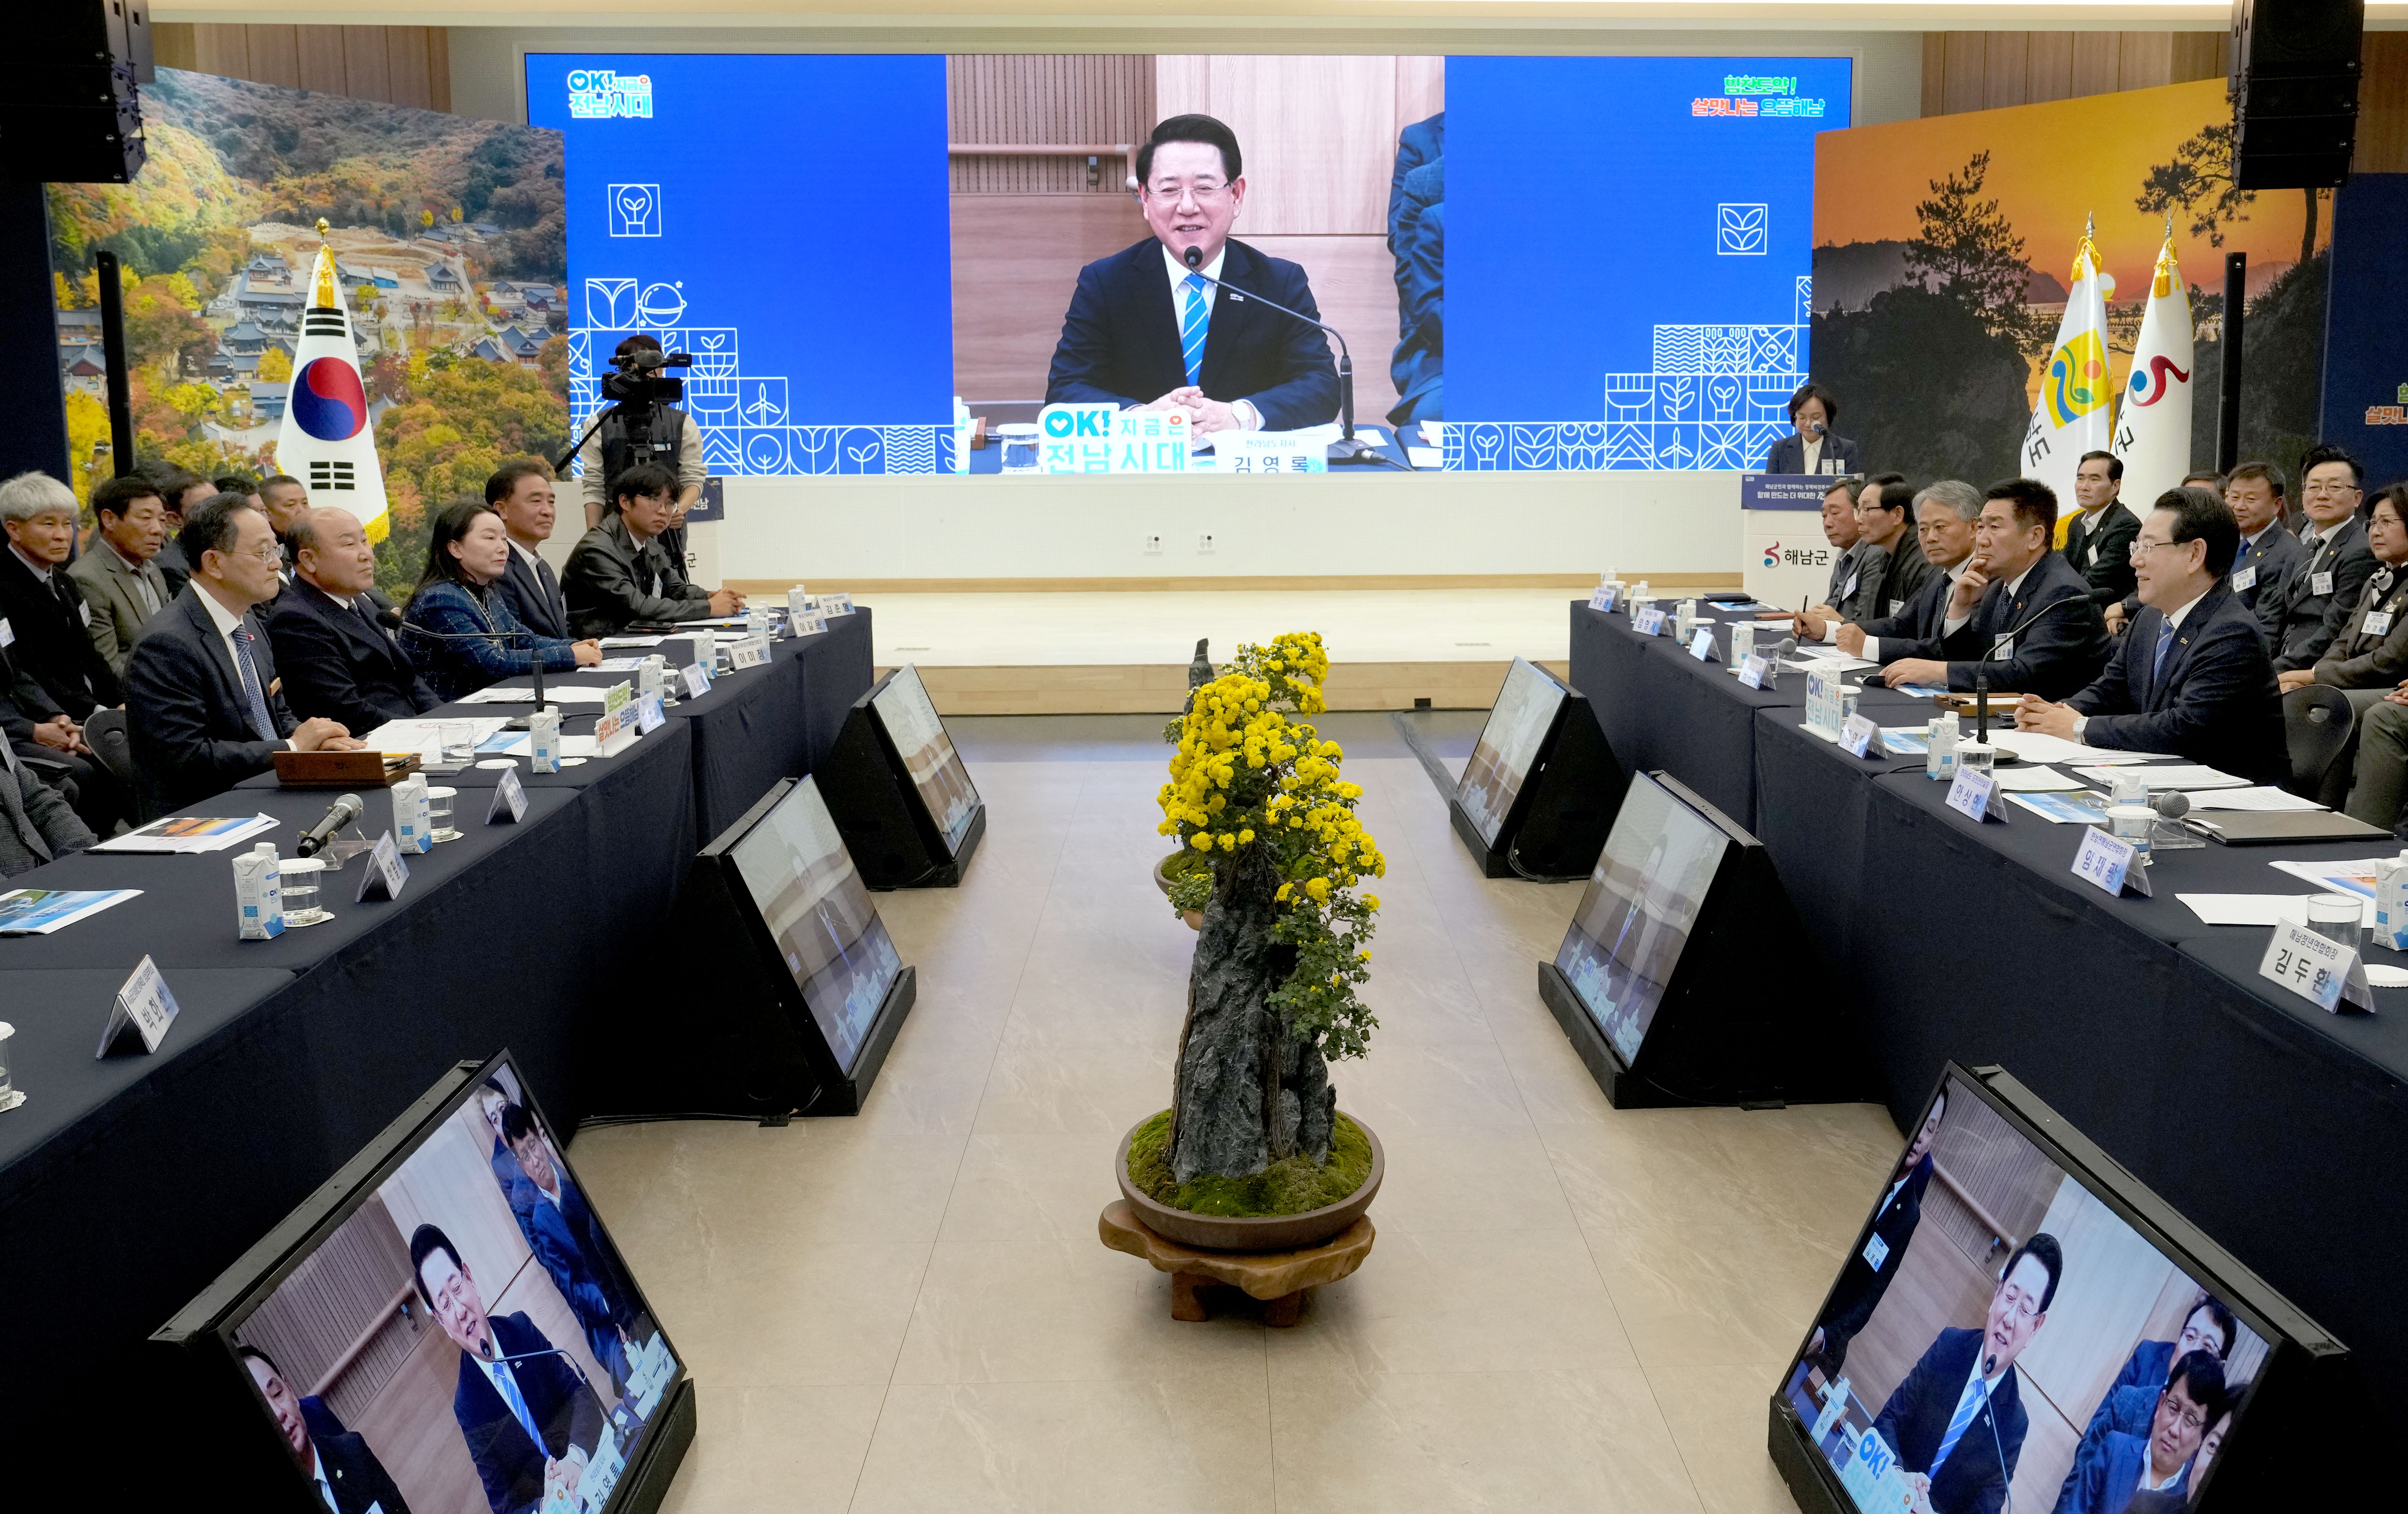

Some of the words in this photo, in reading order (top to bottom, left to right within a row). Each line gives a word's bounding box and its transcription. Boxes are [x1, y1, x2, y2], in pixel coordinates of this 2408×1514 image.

[569, 71, 614, 92] OK!
[615, 76, 651, 92] 지금은
[569, 94, 652, 118] 전남시대
[1692, 98, 1758, 116] 살맛나는
[1760, 97, 1825, 117] 으뜸해남
[1045, 410, 1111, 438] OK!
[1120, 415, 1184, 436] 지금은
[1246, 439, 1296, 449] 전라남도지사
[1784, 549, 1829, 566] 해남군
[738, 648, 765, 664] 이미정
[1808, 674, 1823, 699] OK!
[1824, 688, 1840, 706] 지금은
[598, 716, 619, 742] 살맛나는
[2289, 929, 2338, 960] 해남청년연합회장
[2275, 948, 2331, 996] 김두환
[1860, 1434, 1890, 1480] OK!
